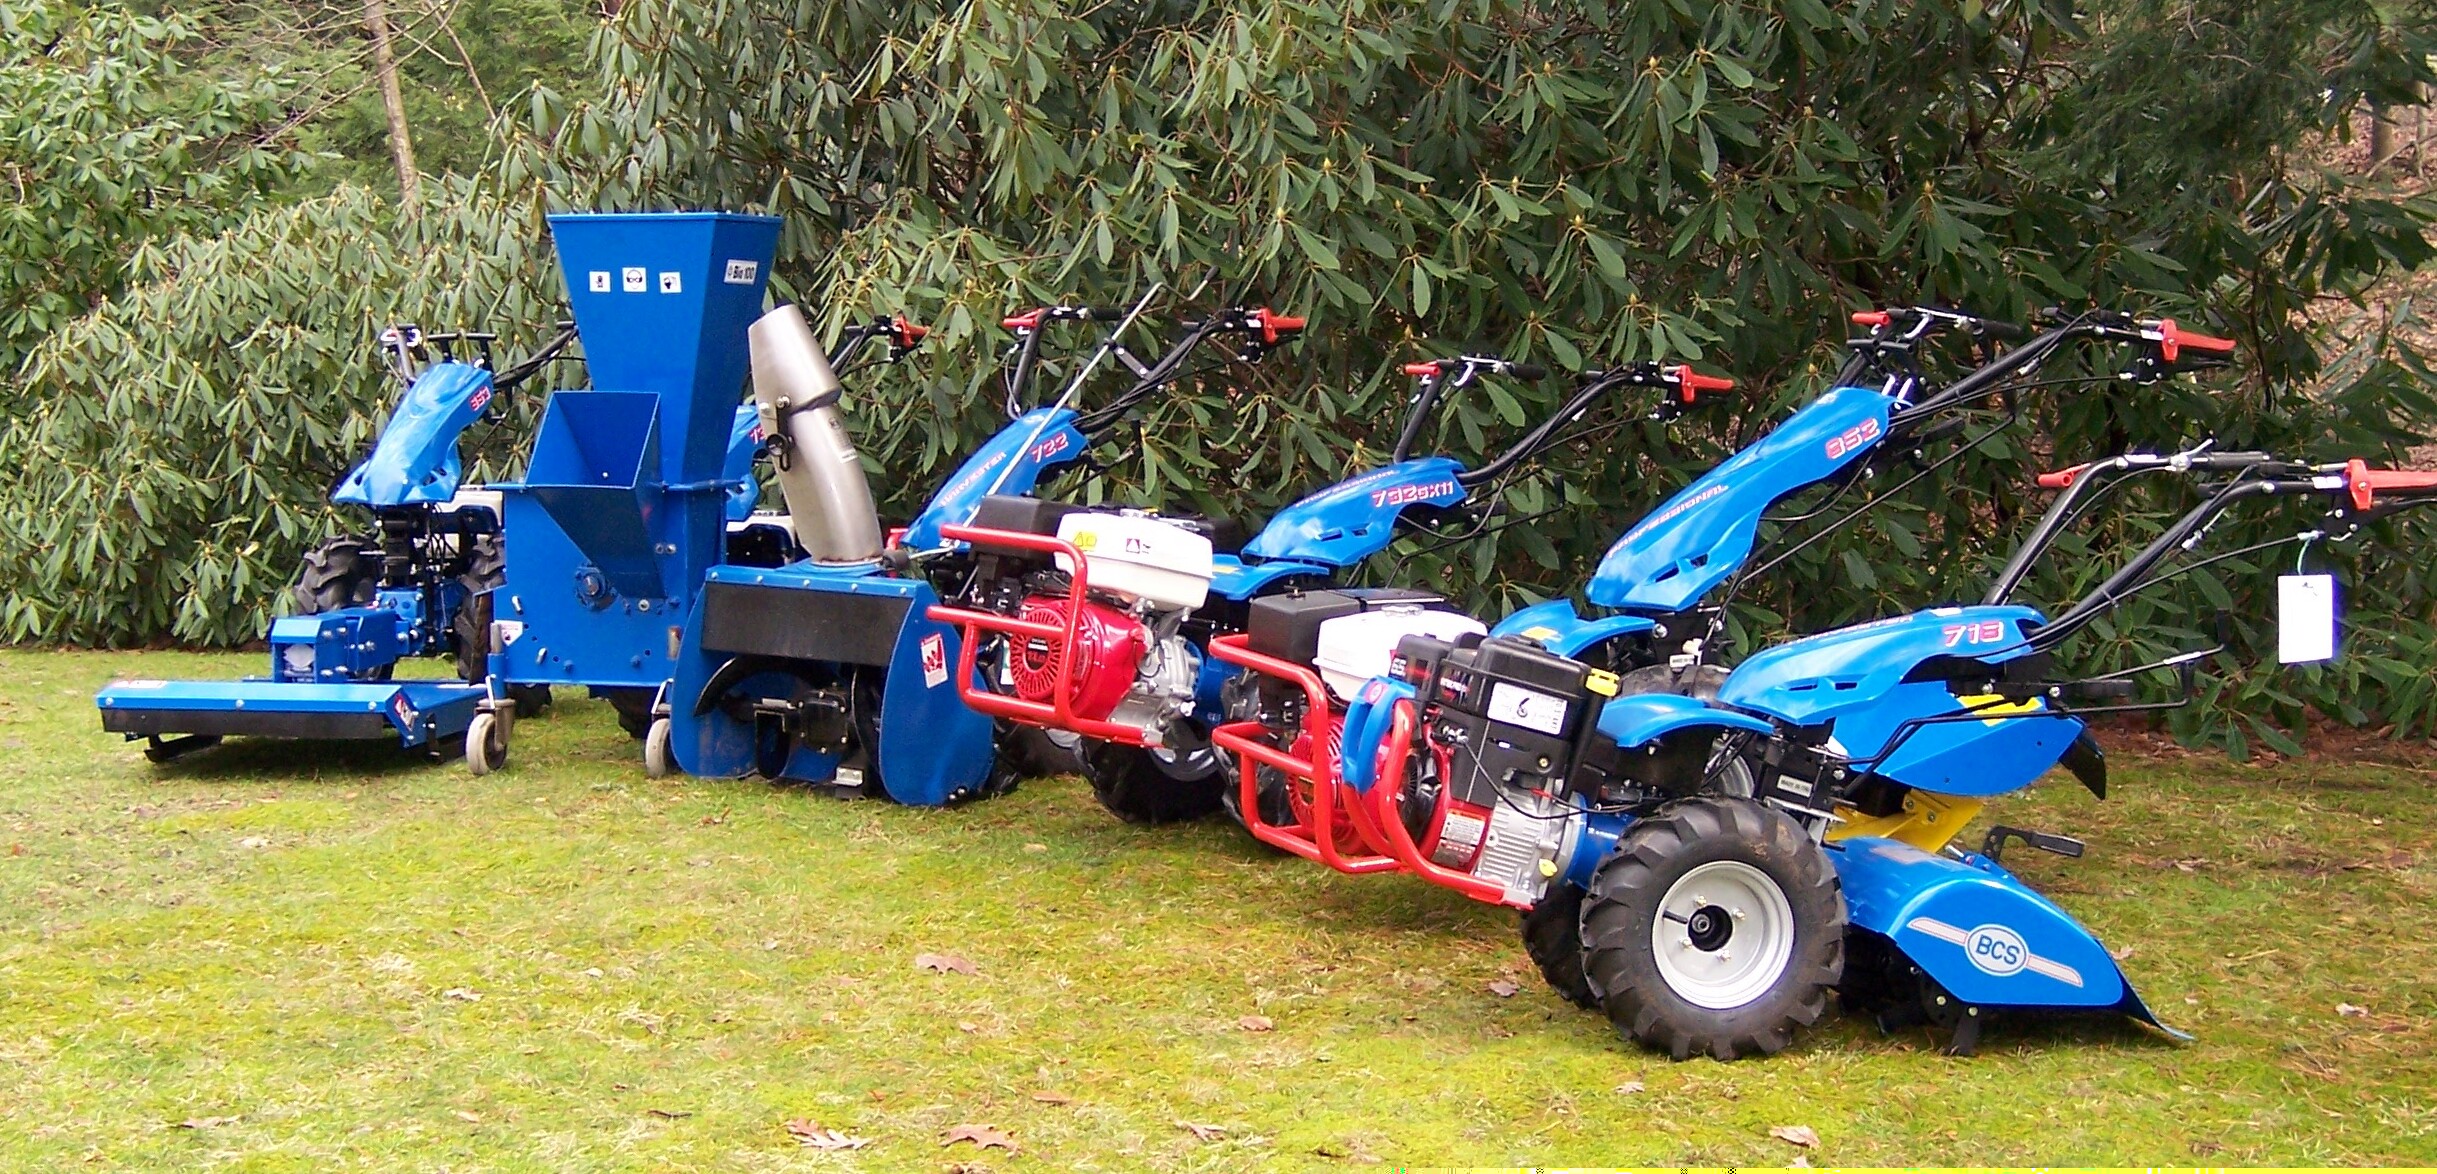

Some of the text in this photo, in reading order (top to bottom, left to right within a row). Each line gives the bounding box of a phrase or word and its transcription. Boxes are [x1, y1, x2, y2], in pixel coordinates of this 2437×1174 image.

[1030, 432, 1070, 464] 722
[1824, 418, 1881, 459] 852
[1942, 620, 2004, 648] 718
[1976, 934, 2020, 965] BCS
